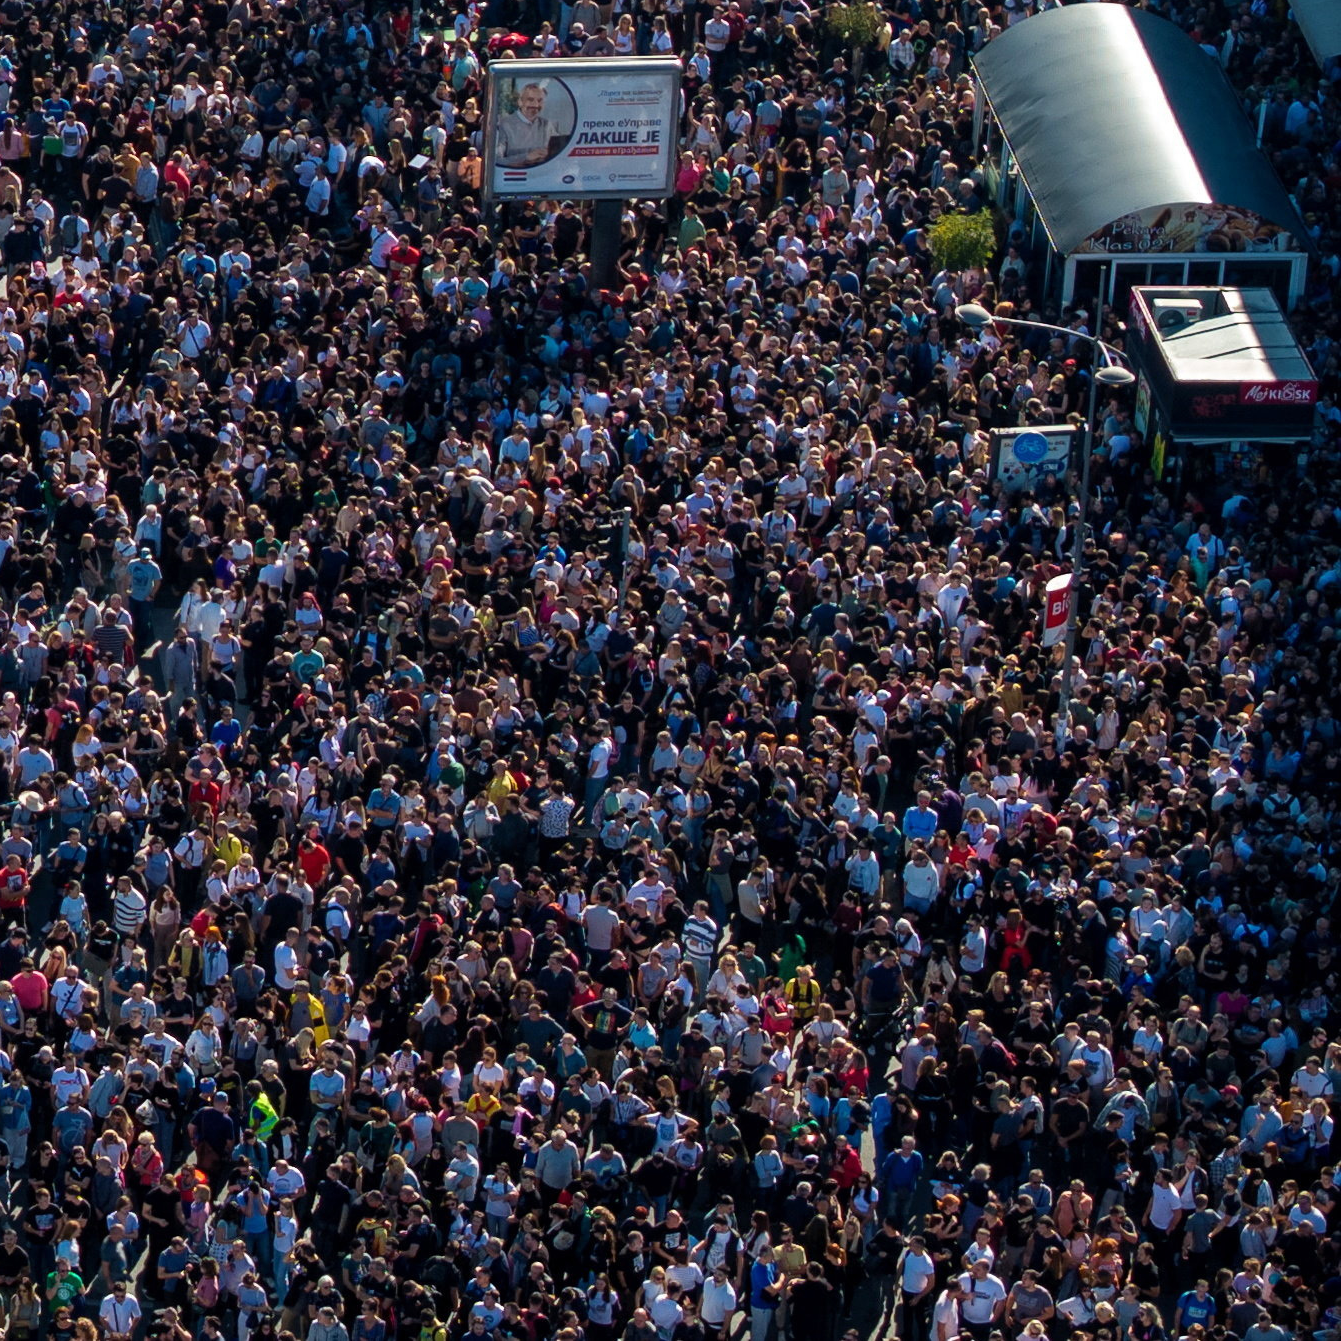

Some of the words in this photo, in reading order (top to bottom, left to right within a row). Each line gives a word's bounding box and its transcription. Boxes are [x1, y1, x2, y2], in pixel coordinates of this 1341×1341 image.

[583, 120, 615, 130] преко
[618, 118, 662, 129] еУправе
[575, 131, 638, 145] ЛАКШЕ
[641, 130, 660, 143] ЈЕ
[1111, 222, 1165, 235] Pekara
[1089, 237, 1133, 251] Klas
[1137, 238, 1176, 250] 021
[1244, 384, 1269, 402] Moj
